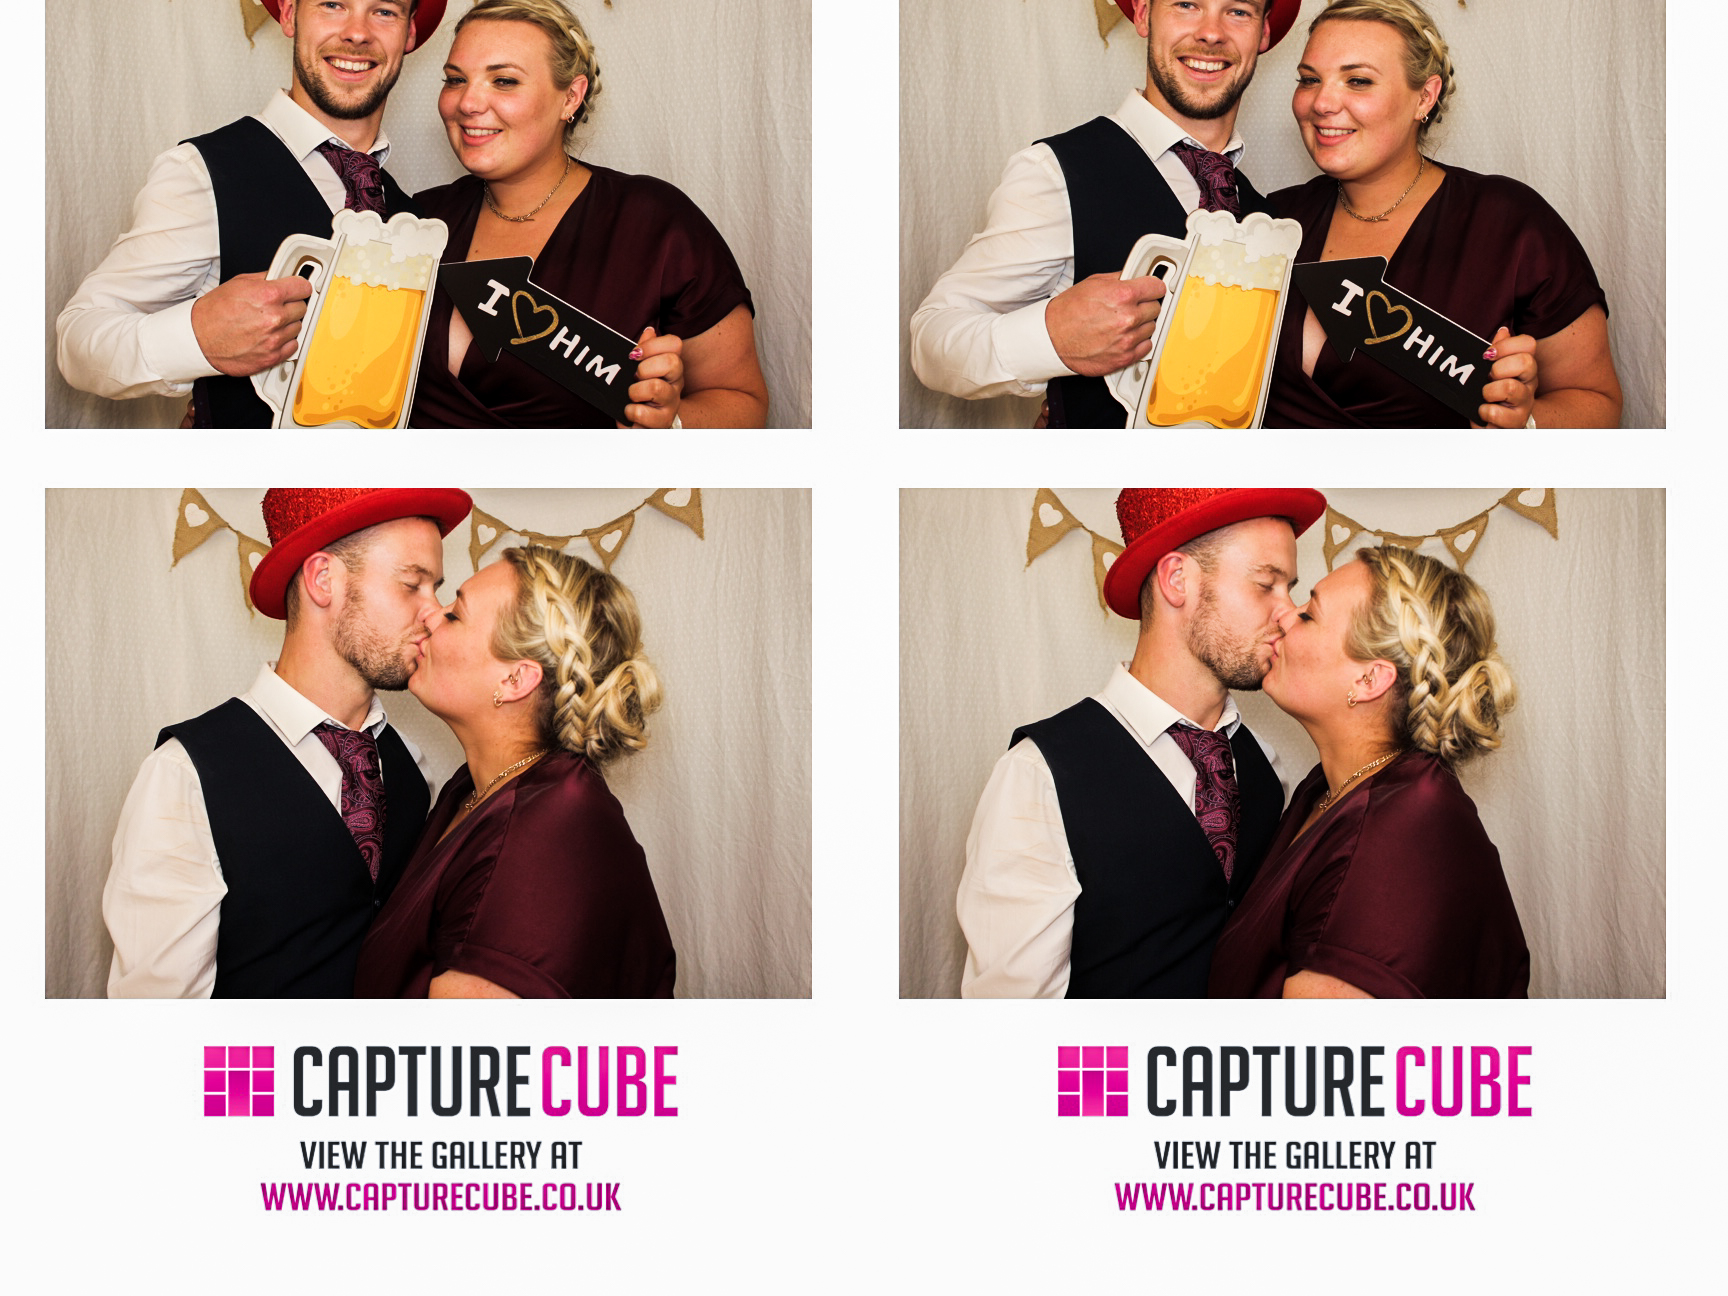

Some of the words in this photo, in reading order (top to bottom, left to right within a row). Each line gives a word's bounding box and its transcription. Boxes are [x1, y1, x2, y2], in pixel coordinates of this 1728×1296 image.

[477, 279, 511, 317] I
[549, 326, 622, 386] HIM
[1331, 279, 1365, 317] I
[1403, 326, 1476, 386] HIM
